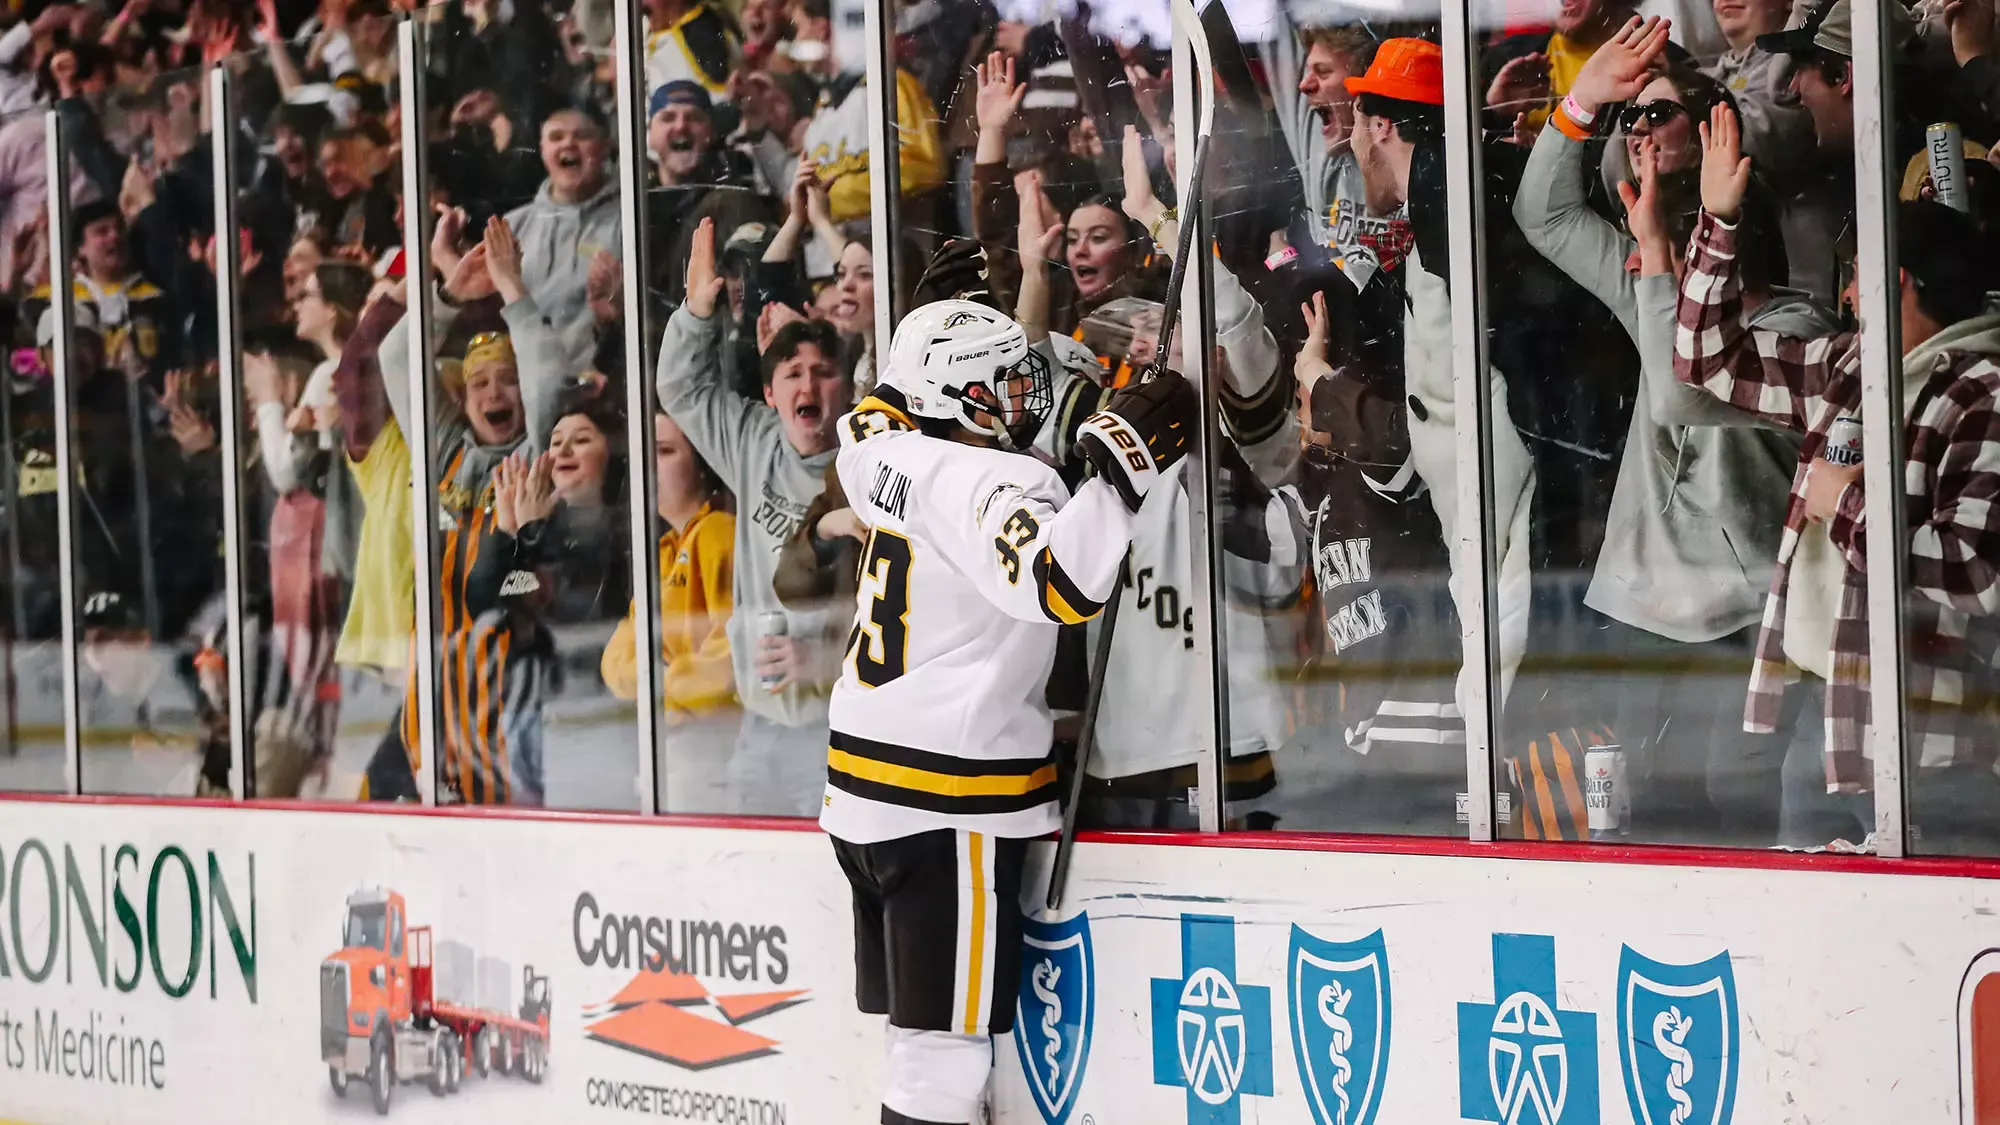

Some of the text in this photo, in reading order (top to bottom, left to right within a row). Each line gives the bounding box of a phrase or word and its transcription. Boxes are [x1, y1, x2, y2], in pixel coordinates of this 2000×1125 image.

[955, 350, 990, 362] BAUER
[1825, 445, 1863, 465] Blue
[995, 507, 1041, 587] 33
[845, 525, 916, 689] 3
[573, 891, 789, 985] Consumers
[34, 1007, 165, 1090] Medicine
